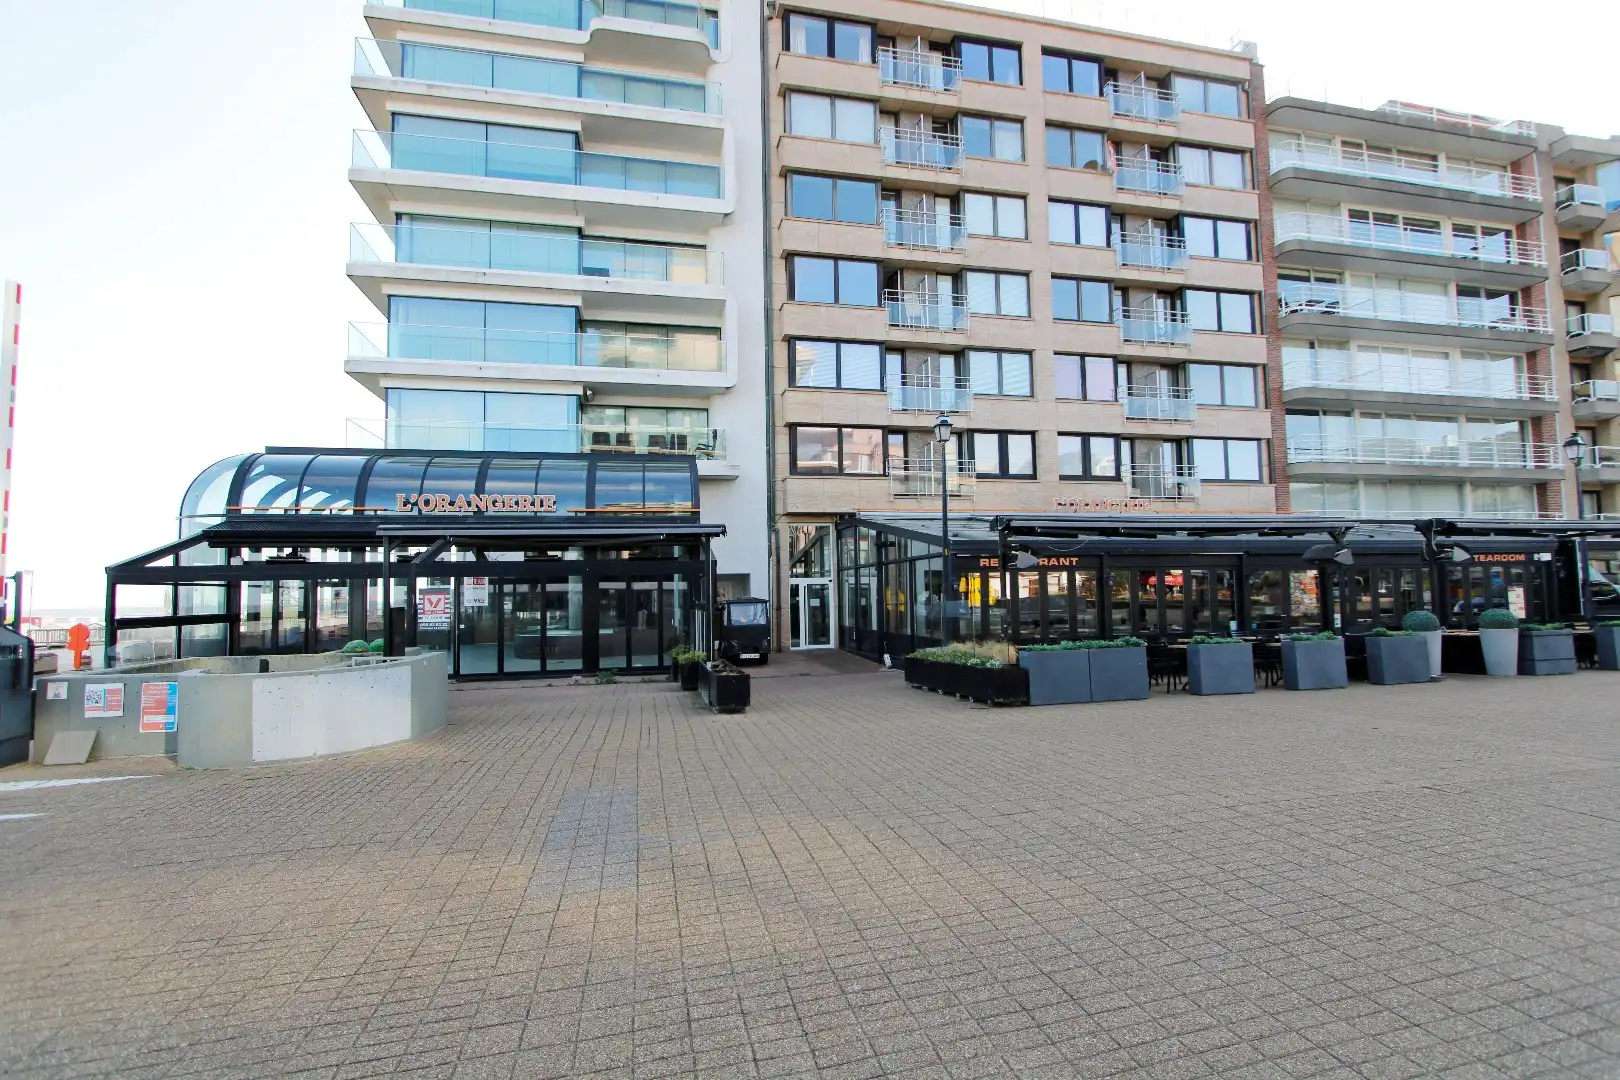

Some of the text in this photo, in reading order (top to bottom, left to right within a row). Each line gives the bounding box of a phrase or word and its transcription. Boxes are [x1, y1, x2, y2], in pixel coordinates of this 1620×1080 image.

[396, 493, 557, 512] L'ORANGERIE
[980, 557, 1079, 567] RERANT
[1472, 553, 1526, 562] TEAROOM
